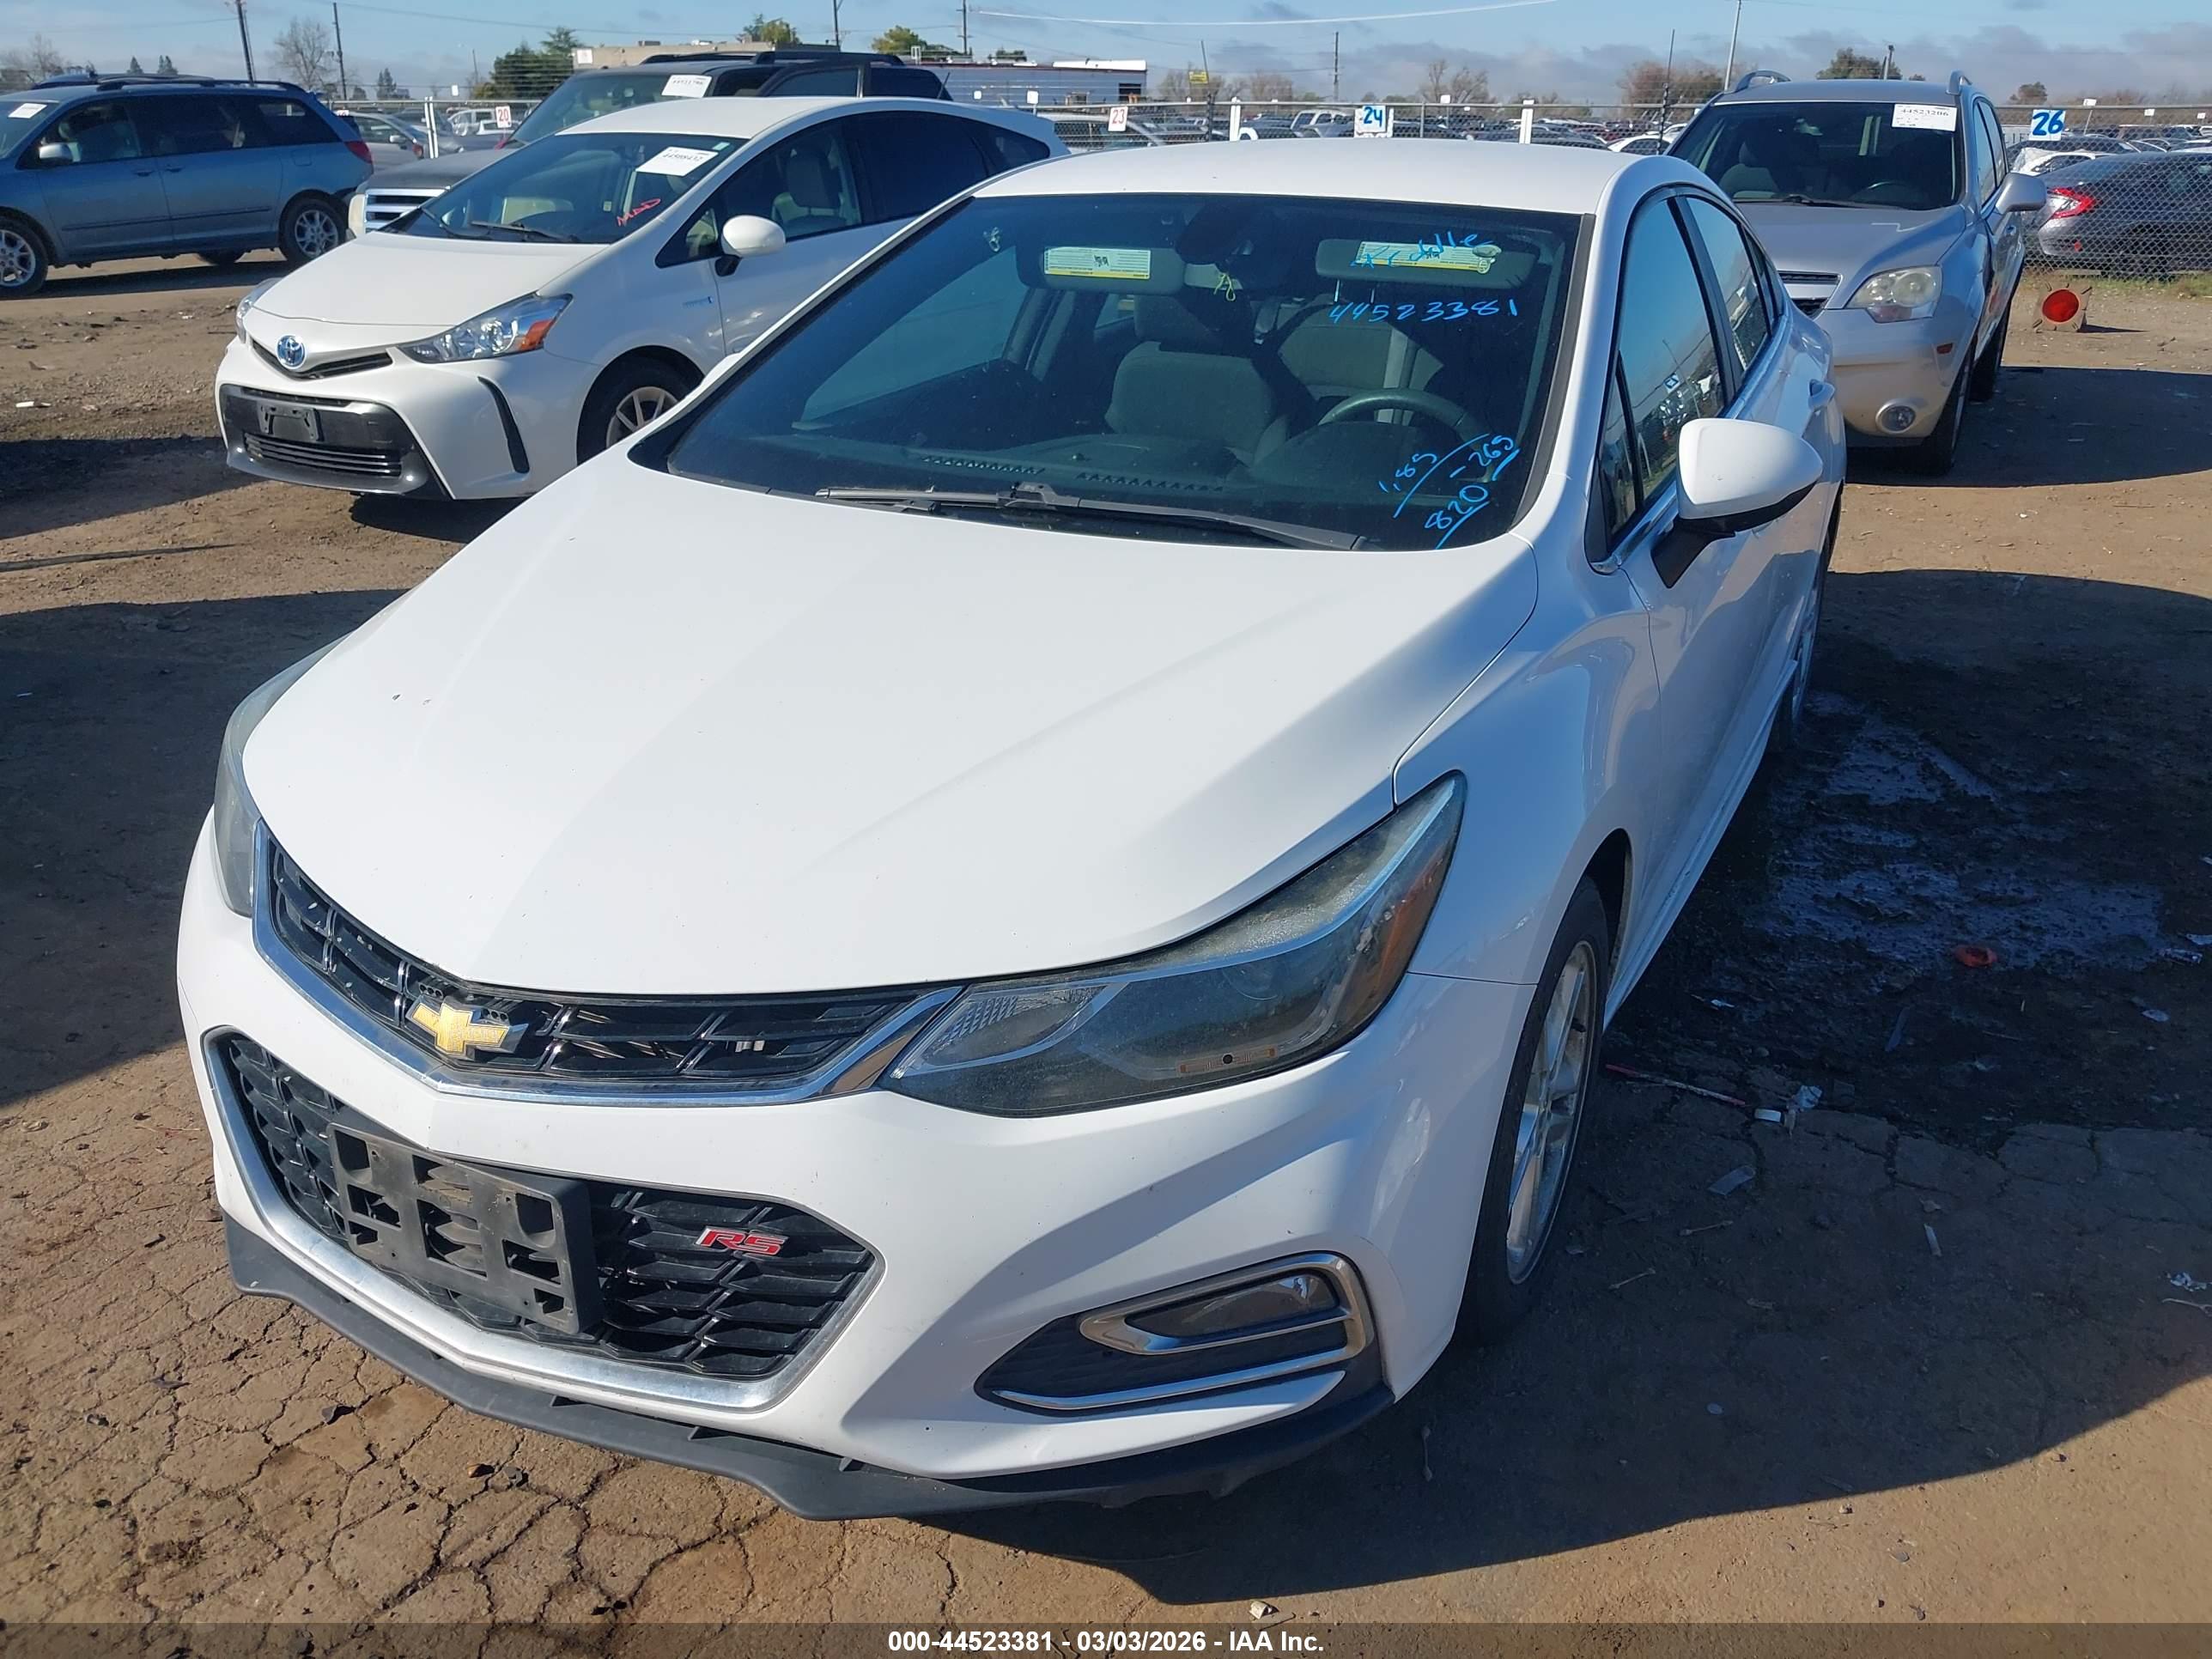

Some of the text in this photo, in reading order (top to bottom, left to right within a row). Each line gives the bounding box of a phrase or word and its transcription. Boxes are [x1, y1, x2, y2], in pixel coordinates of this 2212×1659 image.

[497, 108, 509, 122] 20
[1112, 108, 1125, 125] 23
[1363, 106, 1383, 128] 24
[2032, 110, 2064, 137] 26
[1329, 299, 1517, 324] 44523381
[1424, 484, 1488, 529] 820
[694, 1225, 787, 1255] RS
